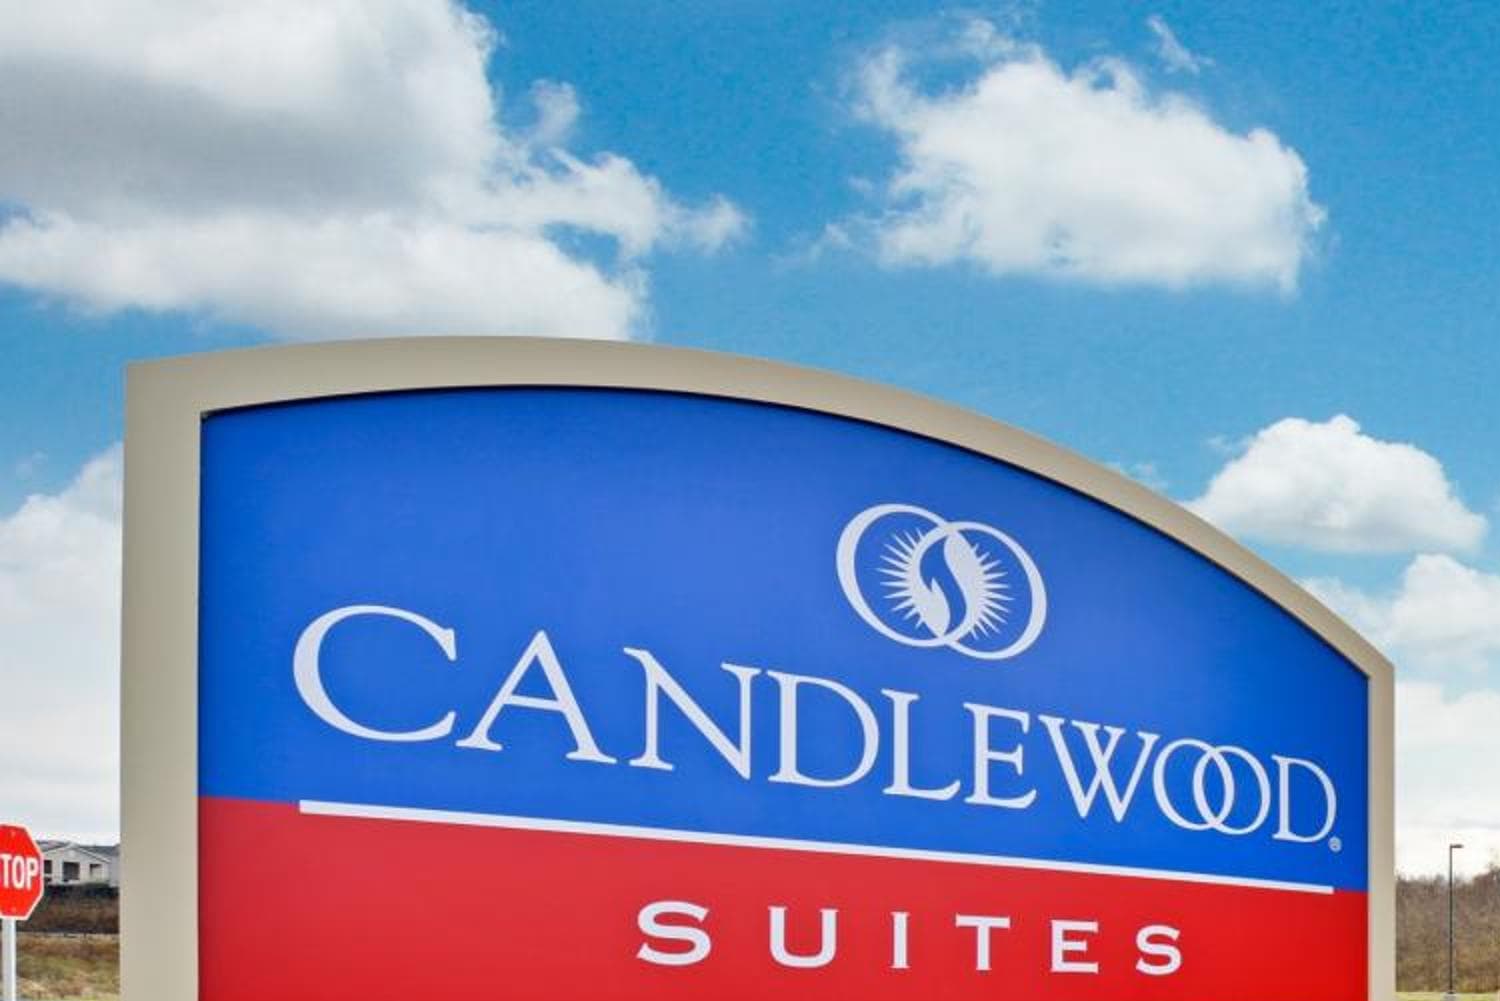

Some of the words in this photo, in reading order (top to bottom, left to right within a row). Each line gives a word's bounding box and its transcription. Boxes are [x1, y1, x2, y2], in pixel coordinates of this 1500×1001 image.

[292, 604, 1337, 843] CANDLEWOOD
[0, 853, 39, 891] TOP
[635, 900, 1183, 976] SUITES
